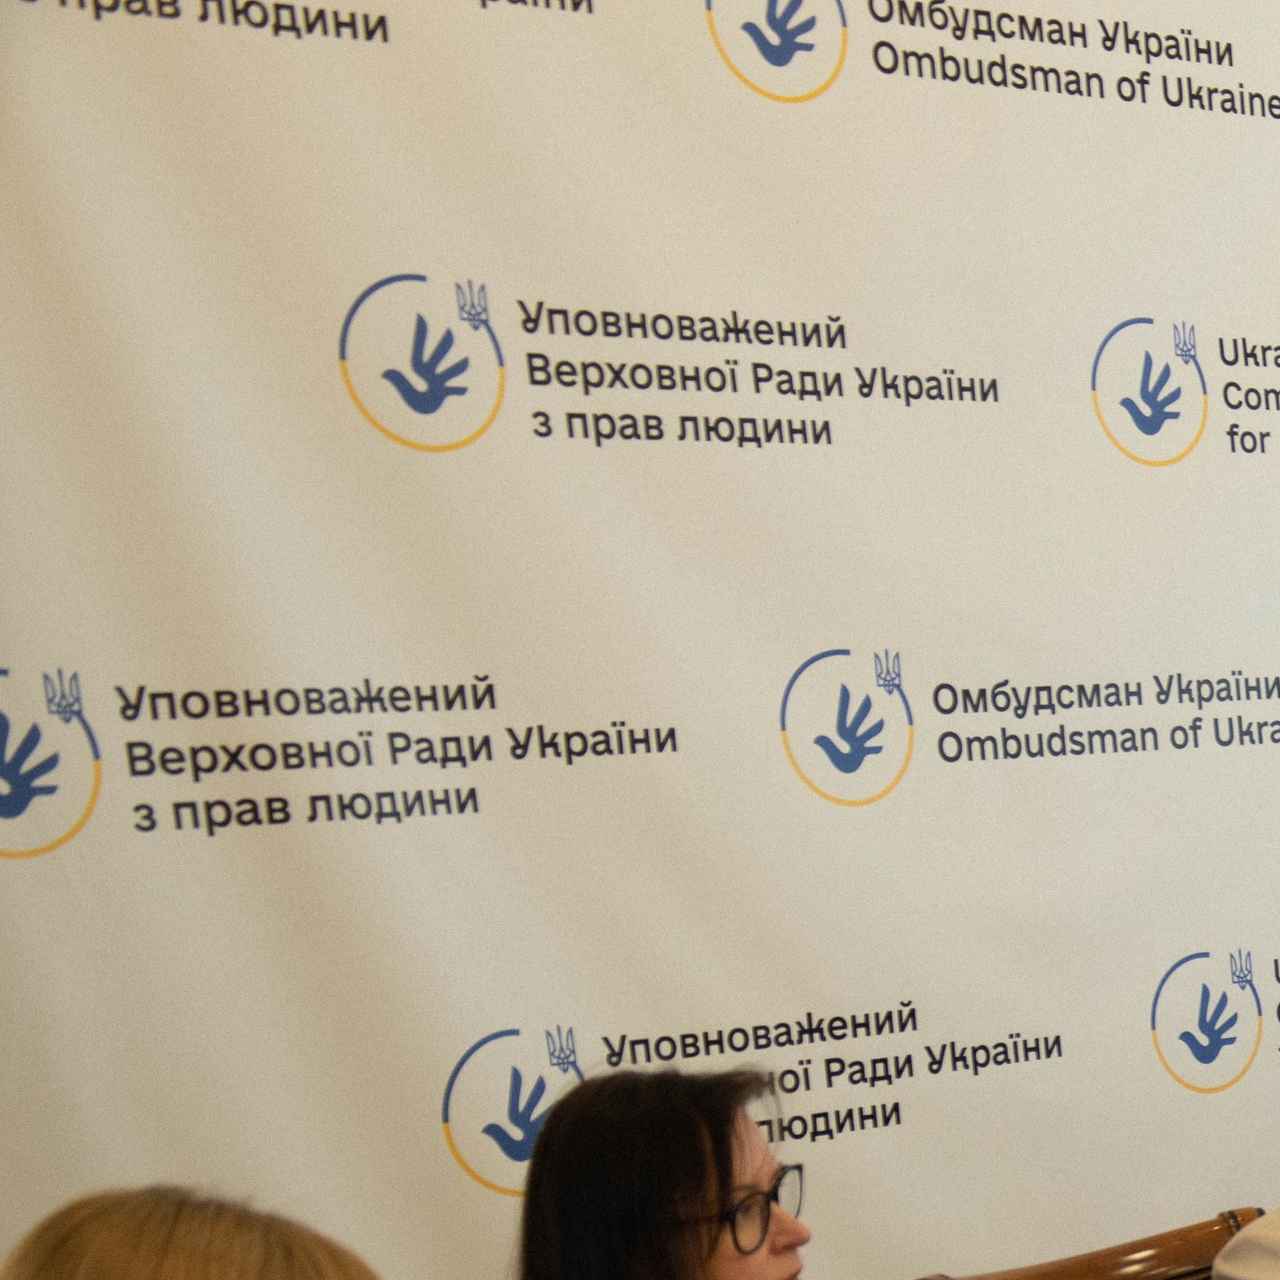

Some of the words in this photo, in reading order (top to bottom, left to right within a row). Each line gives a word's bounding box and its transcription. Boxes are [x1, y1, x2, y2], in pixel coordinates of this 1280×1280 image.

[58, 0, 182, 22] рав
[198, 0, 389, 44] людини
[867, 0, 1088, 49] Омбудсман
[1097, 18, 1234, 67] України
[872, 40, 1105, 99] Ombudsman
[1116, 70, 1151, 104] of
[516, 299, 847, 350] Уповноважений
[525, 352, 739, 397] Верховної
[751, 362, 844, 402] Ради
[853, 366, 999, 408] України
[531, 410, 554, 439] з
[565, 412, 665, 448] прав
[677, 415, 832, 449] людини
[1225, 422, 1271, 454] for
[114, 674, 497, 722] Уповноважений
[932, 678, 1143, 720] Омбудсман
[125, 730, 373, 784] Верховної
[387, 731, 493, 770] Ради
[505, 720, 678, 766] України
[937, 723, 1159, 764] Ombudsman
[1169, 716, 1204, 750] of
[132, 803, 158, 833] з
[172, 796, 292, 837] прав
[306, 786, 480, 825] людини
[601, 1000, 918, 1067] Уповноважений
[824, 1053, 914, 1088] Ради
[924, 1032, 1063, 1077] України
